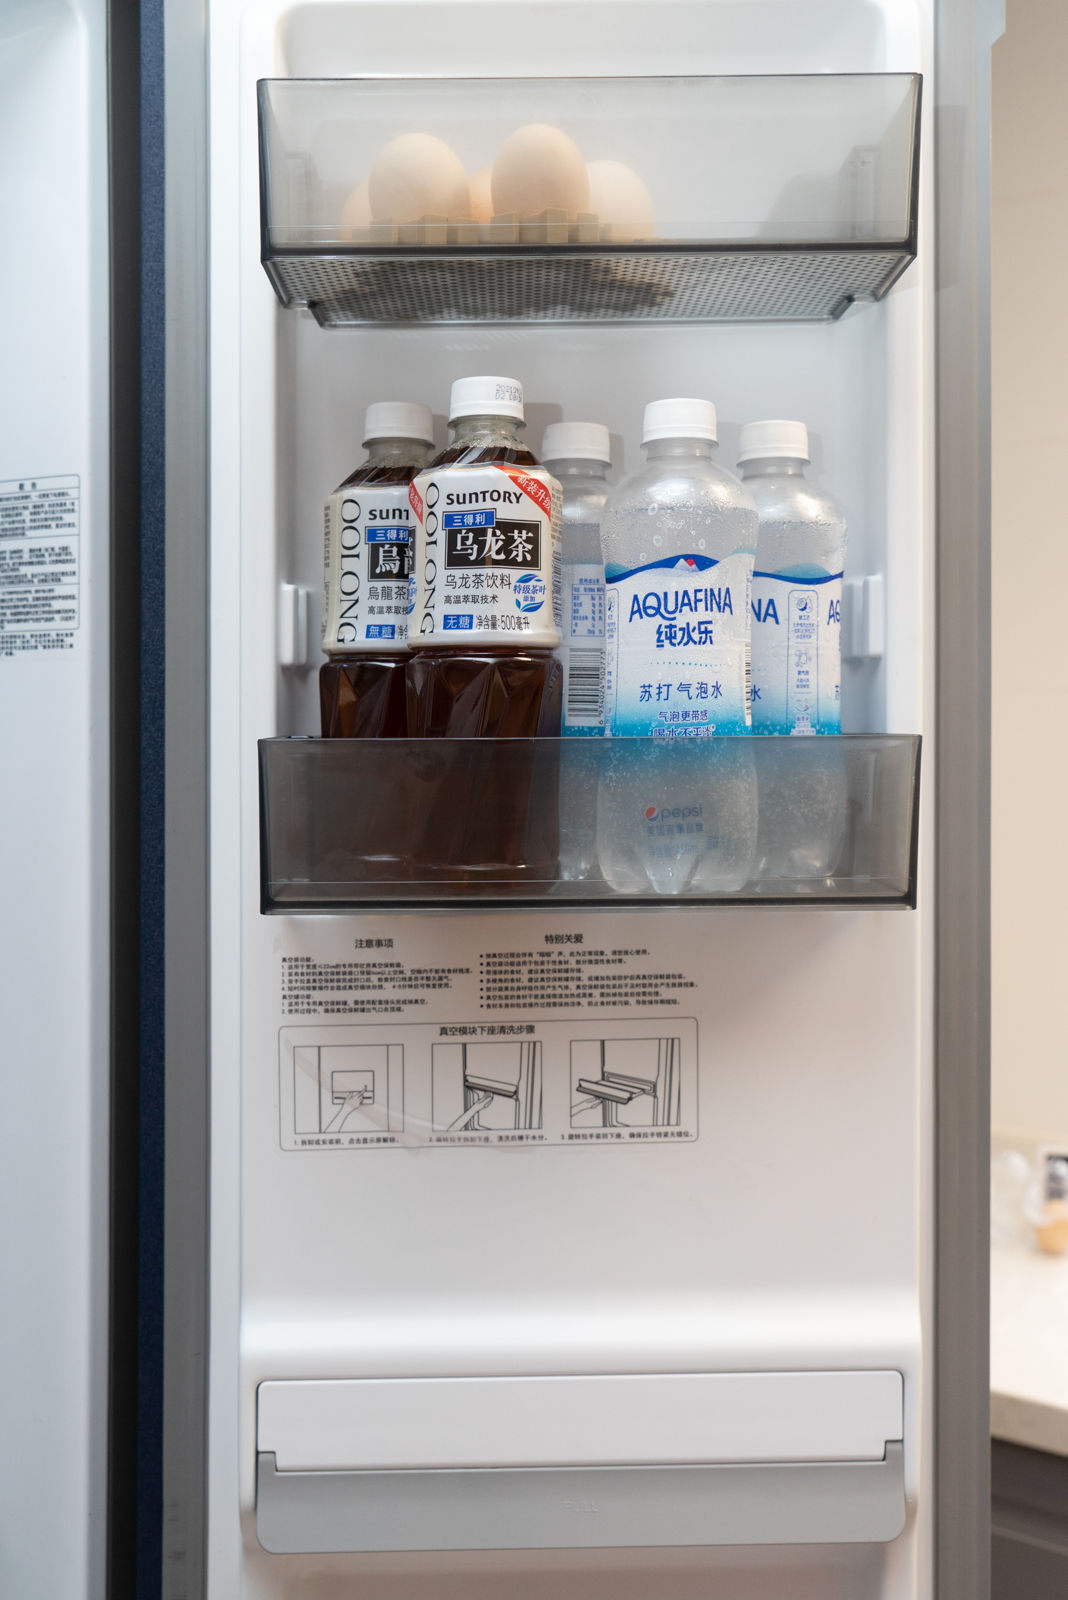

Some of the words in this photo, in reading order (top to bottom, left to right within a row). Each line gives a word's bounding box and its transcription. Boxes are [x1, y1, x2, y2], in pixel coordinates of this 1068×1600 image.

[517, 476, 551, 512] 新装升级
[452, 513, 486, 526] 三得利
[376, 529, 409, 541] 三得利
[452, 528, 534, 563] 乌龙茶
[420, 482, 440, 635] OOLONG
[337, 498, 361, 644] OOLONG
[444, 573, 512, 590] 乌龙茶饮料
[368, 586, 409, 600] 烏龍茶
[513, 584, 547, 595] 特级茶叶
[444, 594, 499, 605] 高温萃取技术
[629, 587, 733, 622] AQUAFINA
[446, 616, 471, 630] 无糖
[656, 620, 713, 648] 纯水乐
[639, 681, 723, 702] 苏打气泡水
[658, 710, 709, 722] 气泡更带感
[660, 804, 703, 821] pepsi
[354, 938, 394, 949] 注意事项
[544, 934, 584, 944] 特别关爱
[439, 1025, 535, 1036] 真空模块下座清洗步骤
